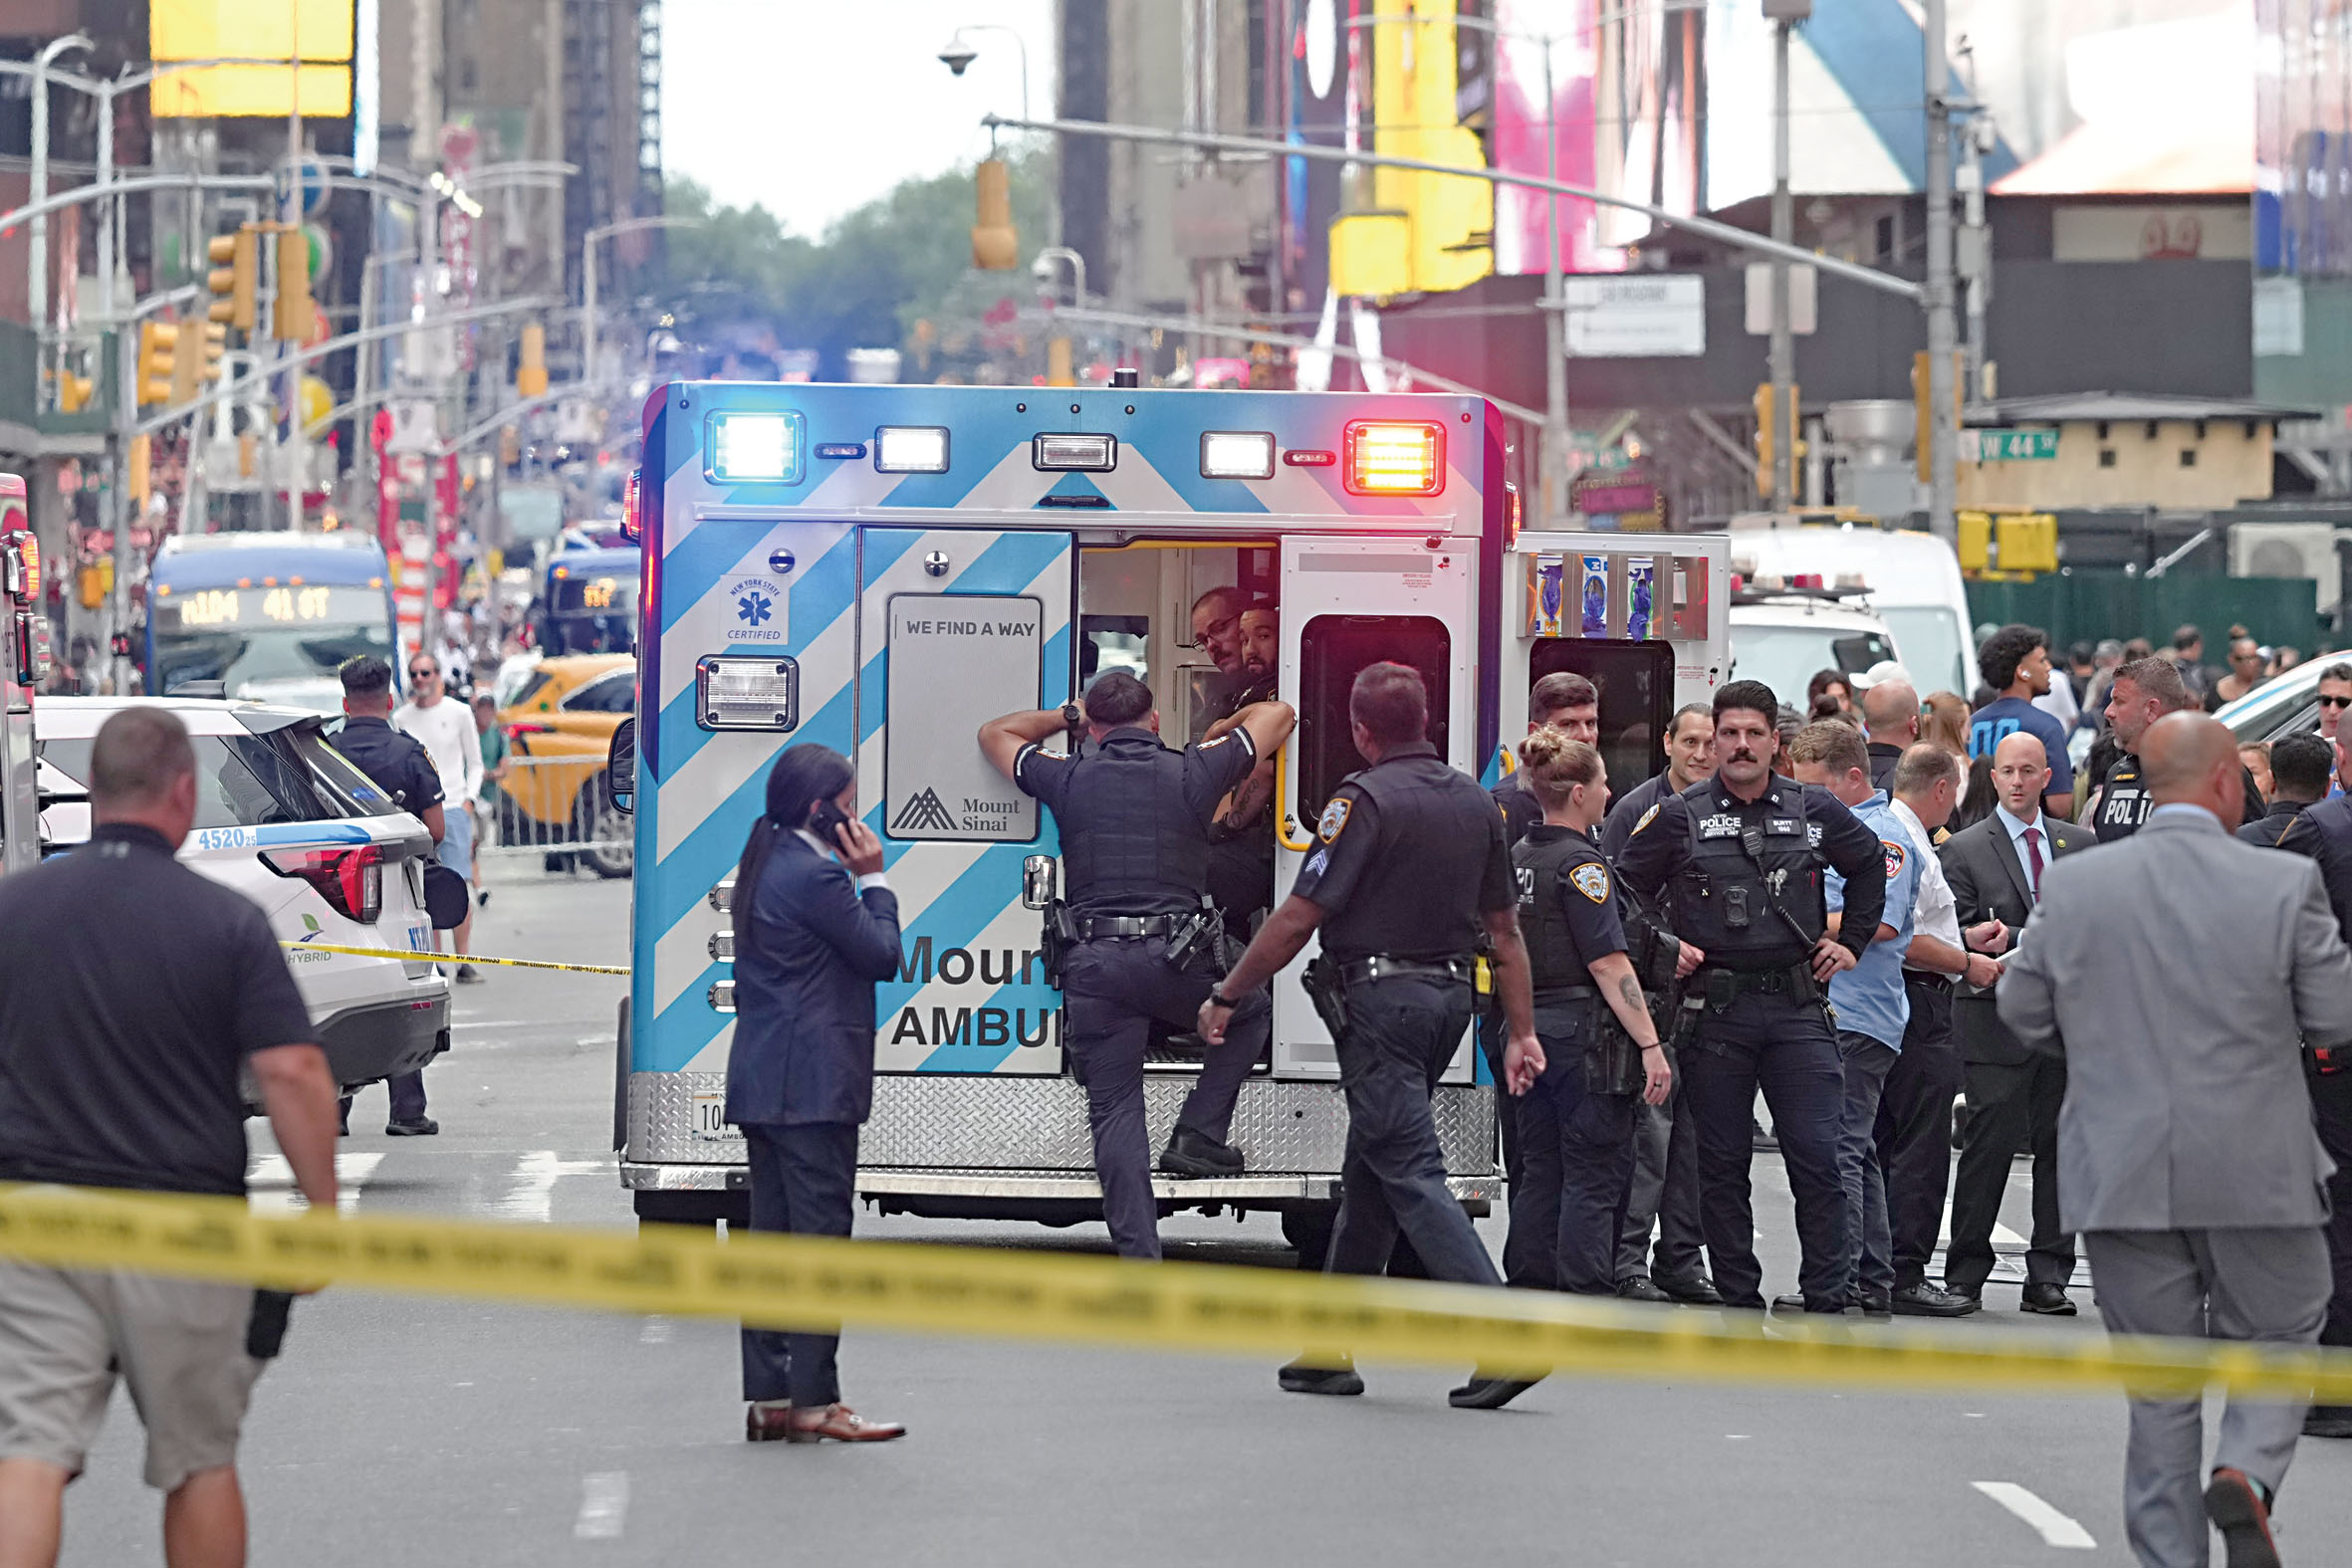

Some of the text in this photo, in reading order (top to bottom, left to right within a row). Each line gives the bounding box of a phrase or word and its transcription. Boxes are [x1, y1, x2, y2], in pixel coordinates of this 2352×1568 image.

[1983, 436, 2001, 457] W
[2008, 435, 2034, 455] 44
[730, 582, 744, 596] NEW
[763, 580, 781, 597] STATE
[727, 629, 781, 640] CERTIFIED
[907, 620, 1036, 637] WE FIND A WAY
[962, 798, 1020, 813] Mount
[2104, 799, 2154, 824] POLIC
[962, 815, 1008, 831] Sinai
[1700, 817, 1742, 829] POLICE
[199, 828, 256, 849] 4520 25
[287, 951, 332, 964] HYBRID
[884, 936, 1052, 986] Moun
